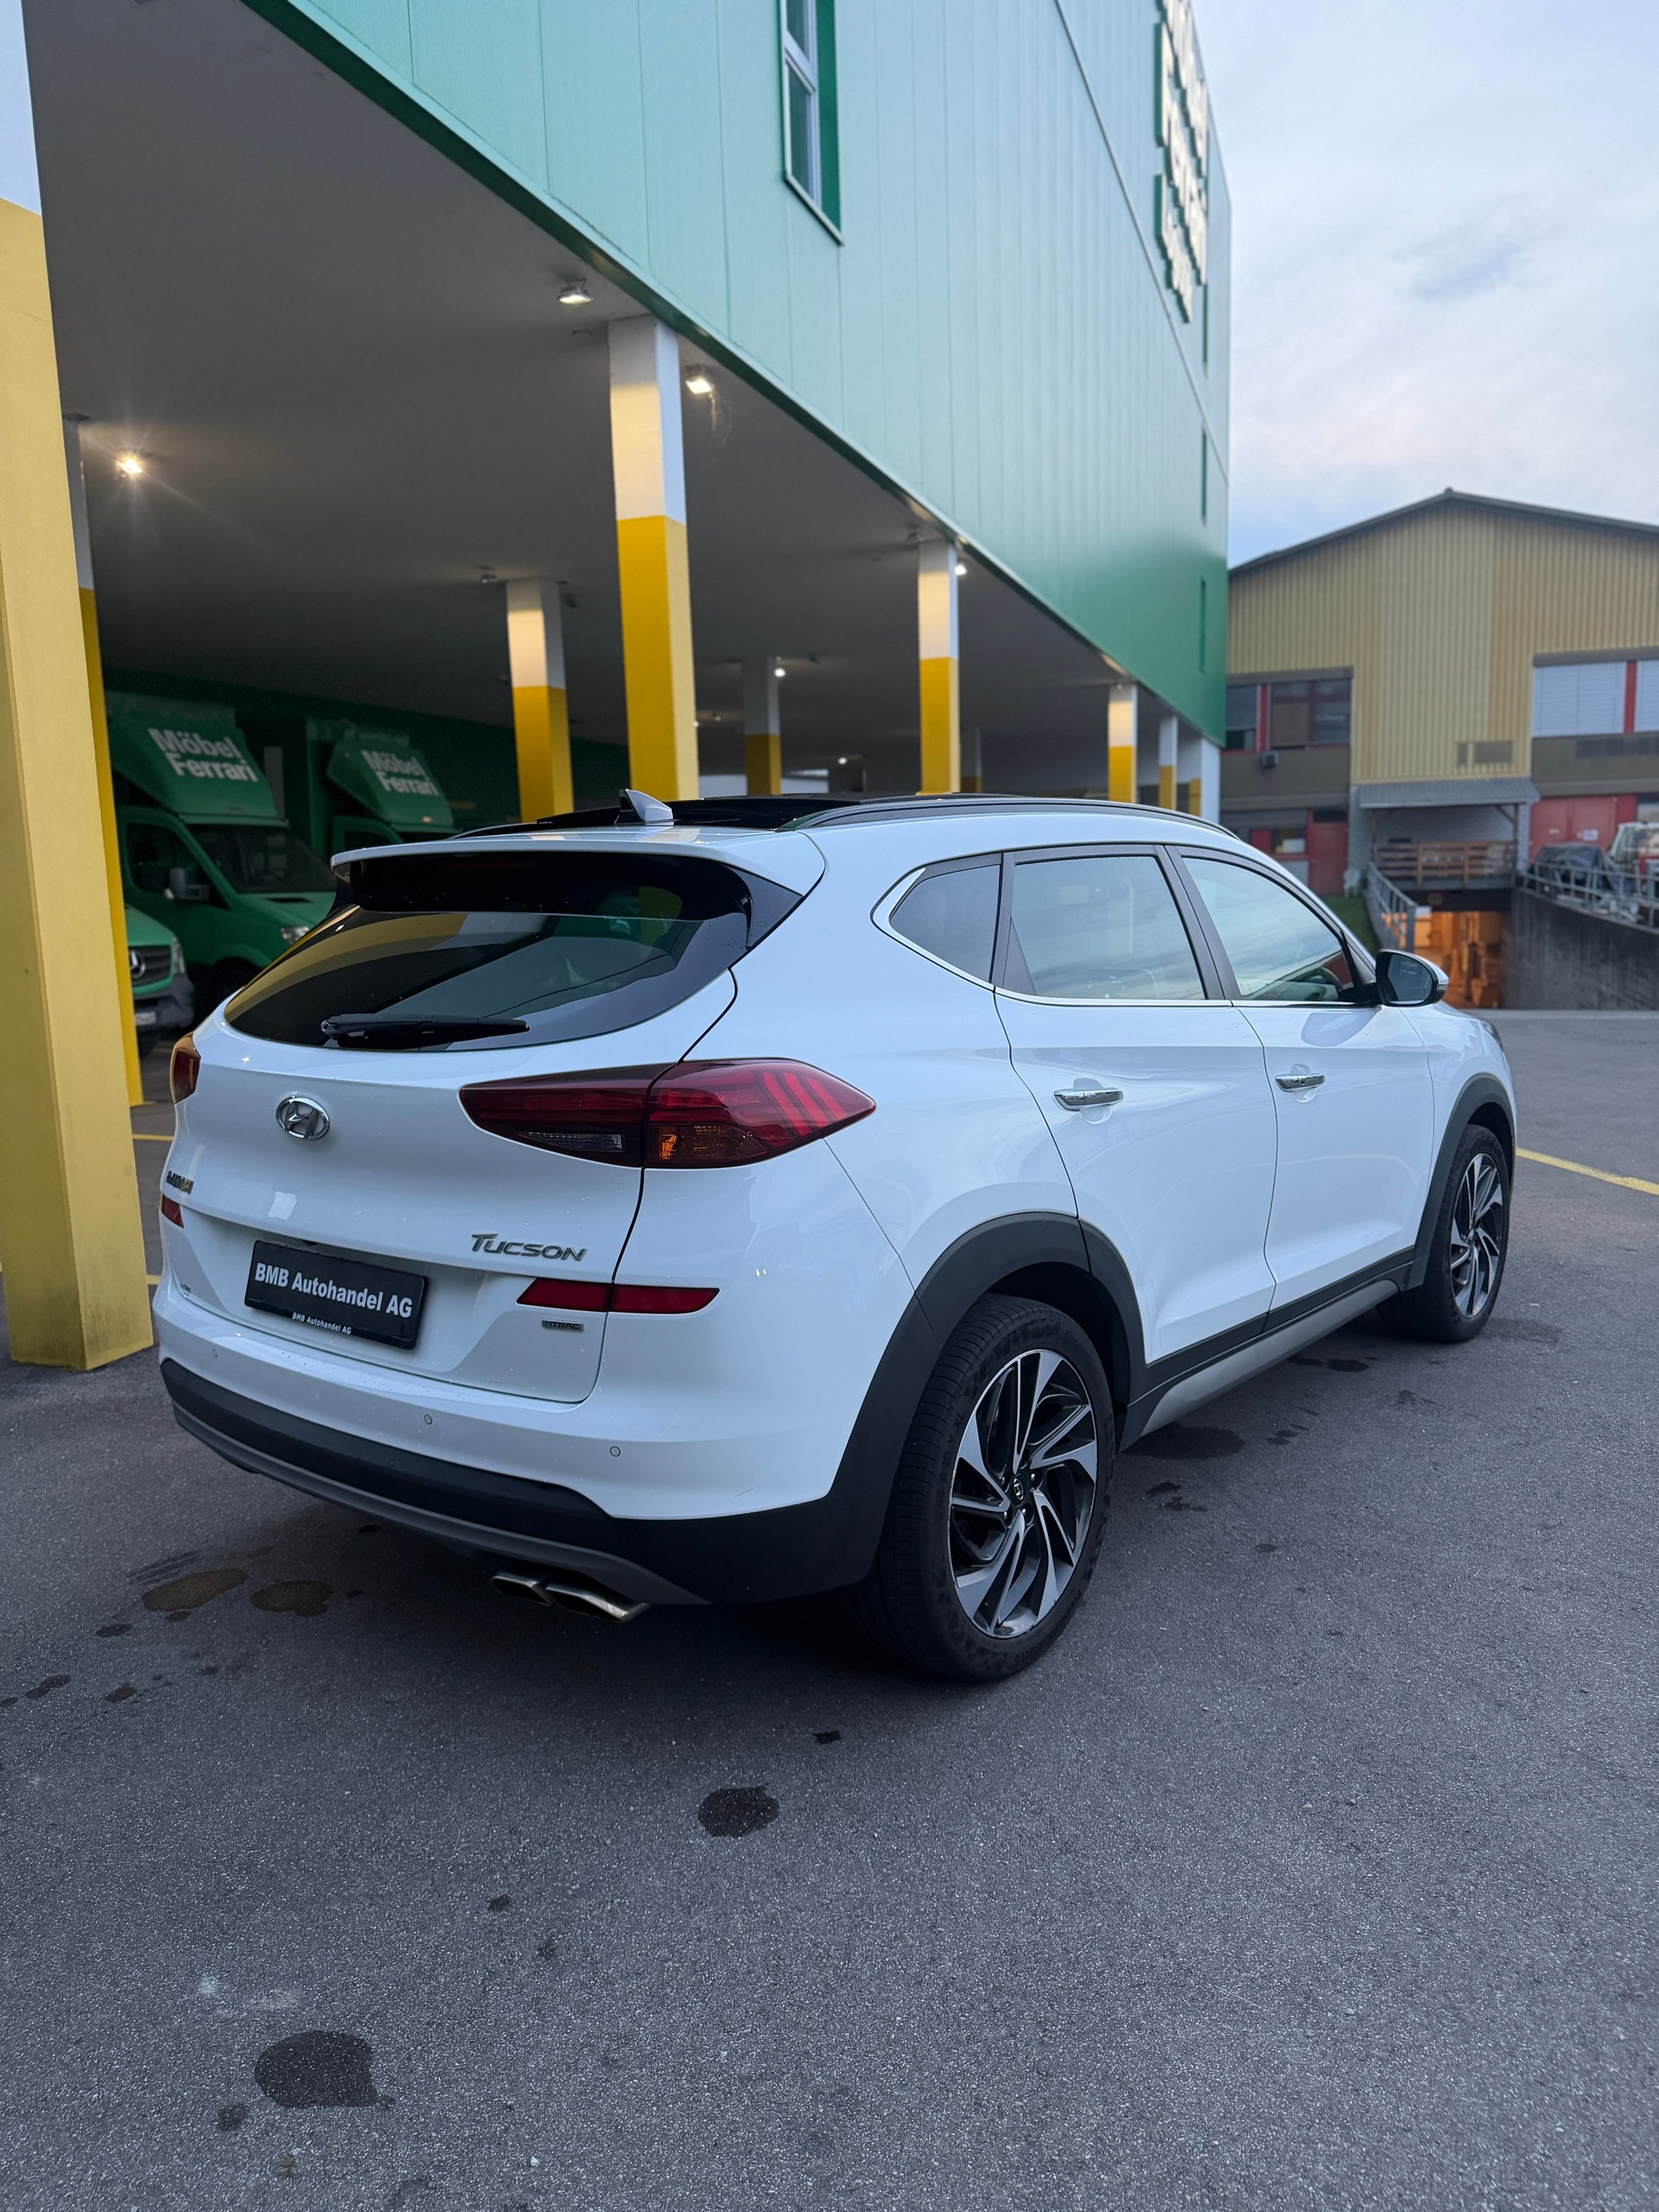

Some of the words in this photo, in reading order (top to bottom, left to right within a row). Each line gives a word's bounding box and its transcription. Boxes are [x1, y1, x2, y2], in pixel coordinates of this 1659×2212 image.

[147, 728, 243, 760] Möbel
[164, 752, 258, 782] Ferrari
[360, 749, 427, 776] Möbel
[375, 771, 440, 797] Ferrari
[255, 1262, 289, 1287] BMB
[291, 1272, 384, 1312] Autohandel
[385, 1294, 413, 1319] AG
[292, 1312, 305, 1322] BMB
[307, 1316, 341, 1332] Autohandel
[342, 1325, 353, 1336] AG
